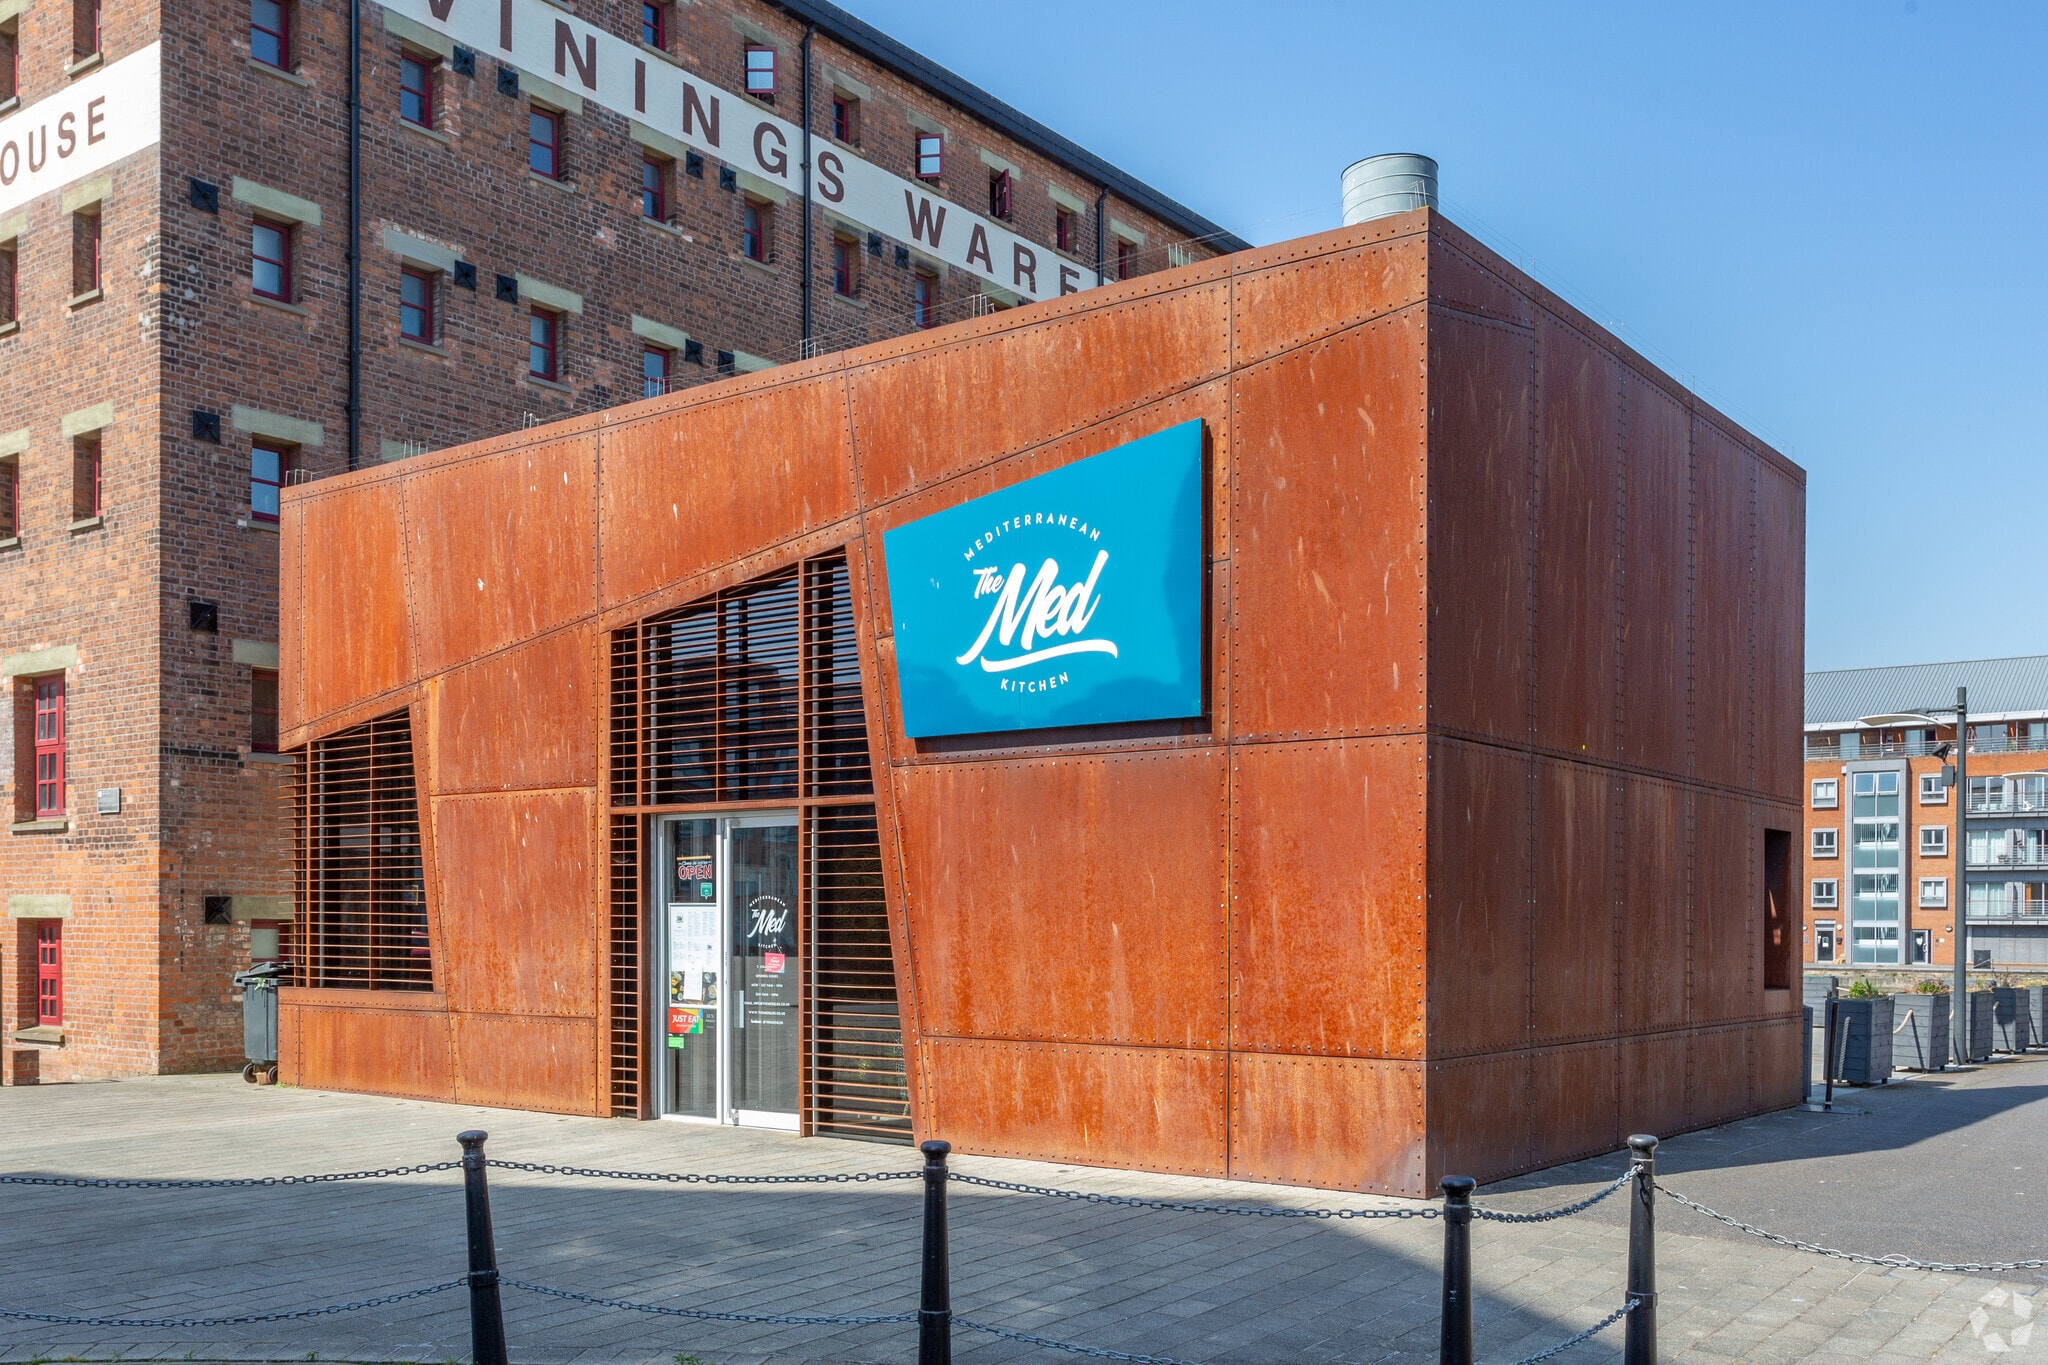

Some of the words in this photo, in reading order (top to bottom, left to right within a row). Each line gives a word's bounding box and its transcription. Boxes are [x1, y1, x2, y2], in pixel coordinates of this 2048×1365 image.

[963, 512, 1101, 562] MEDITERRANEAN
[973, 566, 1005, 599] The
[956, 549, 1109, 665] Med
[1000, 671, 1069, 693] KITCHEN
[678, 864, 712, 880] OPEN
[747, 908, 788, 938] Med
[672, 1014, 688, 1023] JUST
[688, 1015, 700, 1023] EAT
